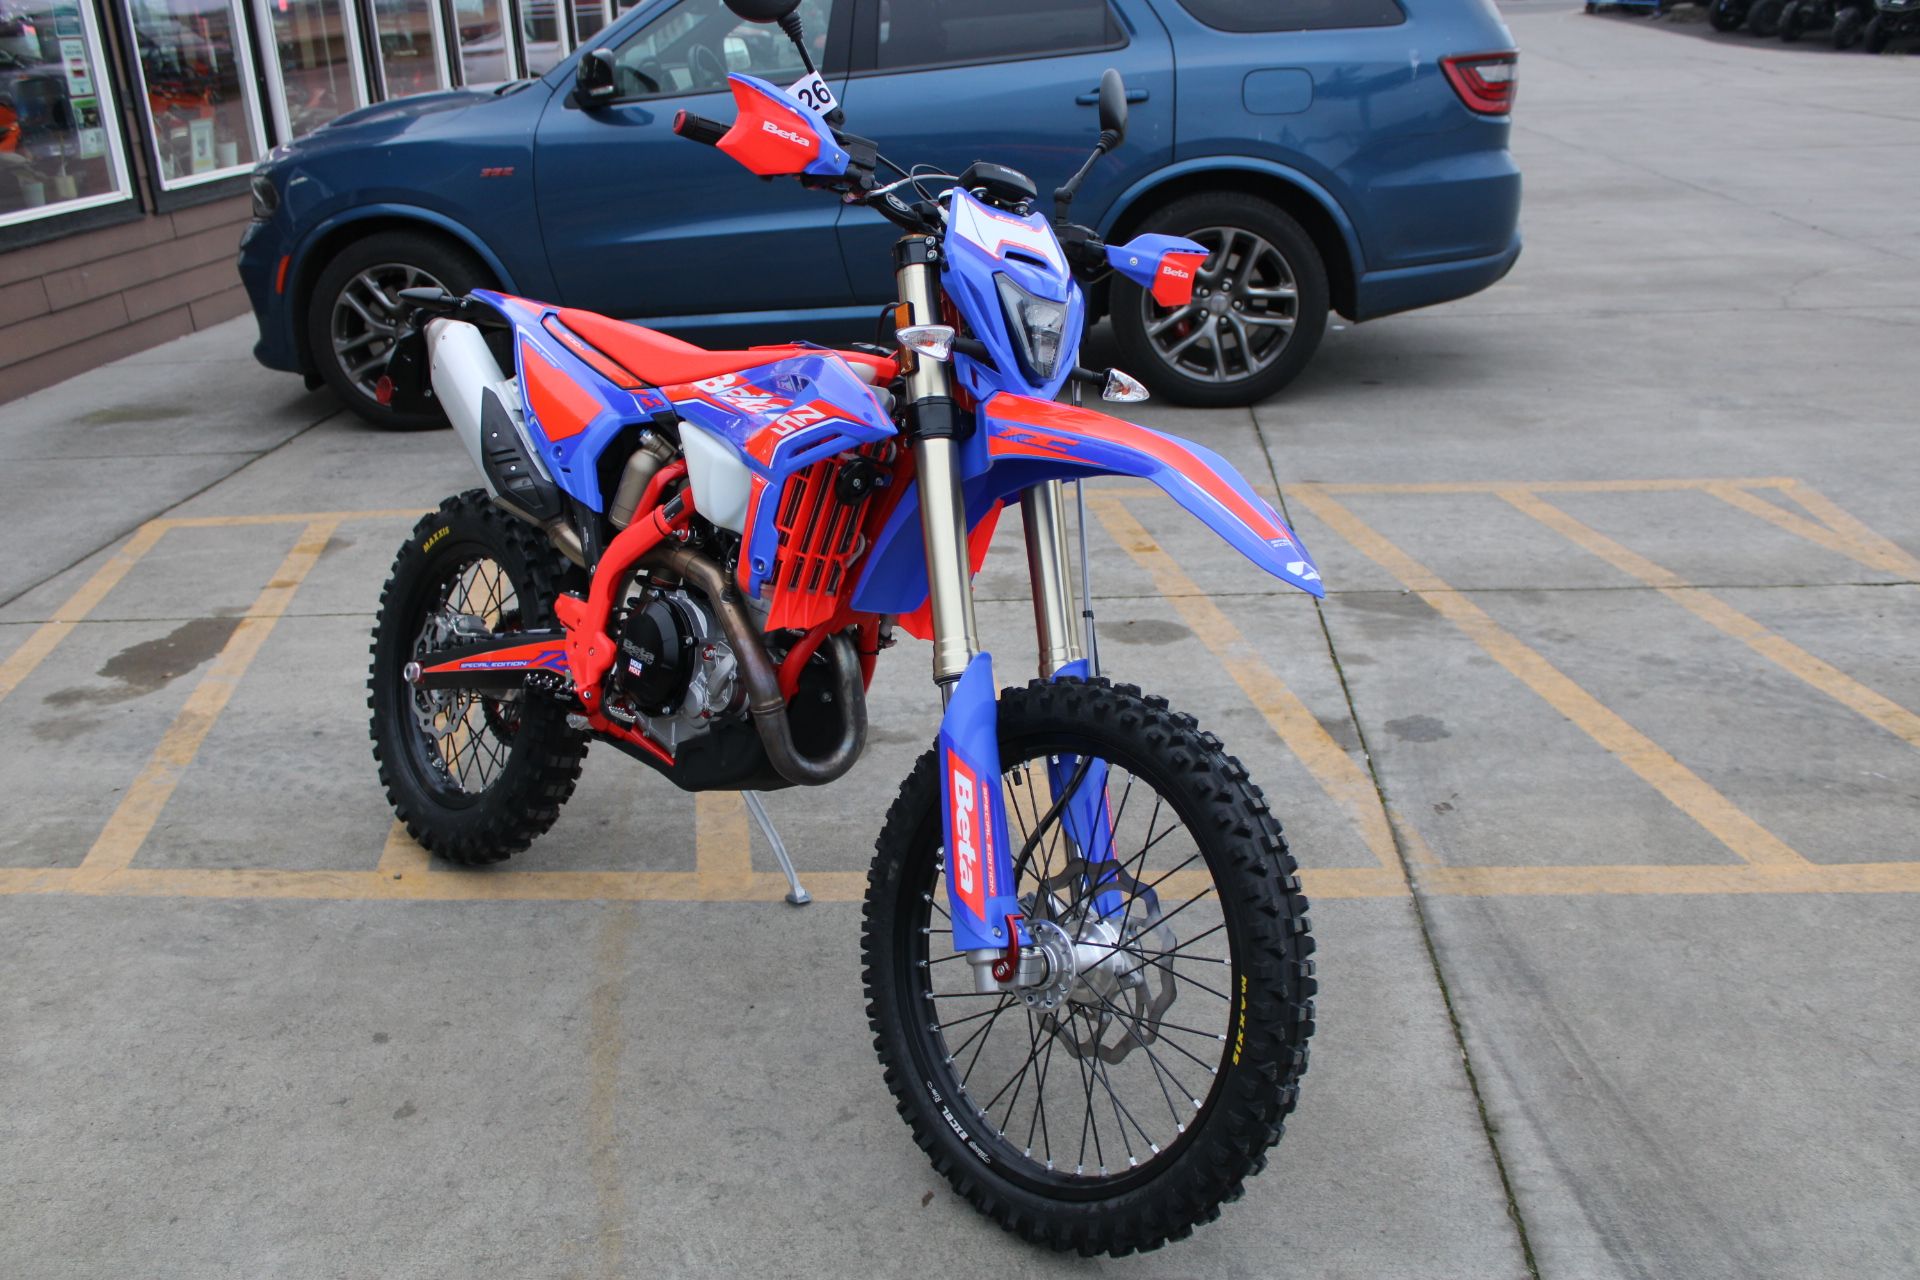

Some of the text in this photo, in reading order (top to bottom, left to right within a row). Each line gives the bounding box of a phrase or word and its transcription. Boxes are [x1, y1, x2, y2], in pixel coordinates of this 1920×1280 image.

[797, 79, 832, 111] 26
[761, 120, 811, 147] Beta
[1162, 265, 1190, 279] Beta
[423, 526, 450, 553] MAXXIS
[623, 638, 655, 660] Beta
[460, 660, 528, 669] SPECIAL EDITION
[953, 769, 977, 895] Beta
[982, 786, 996, 896] SPECIAL EDITION
[1232, 973, 1248, 1066] MAXXIS
[942, 1105, 969, 1141] EXCEL
